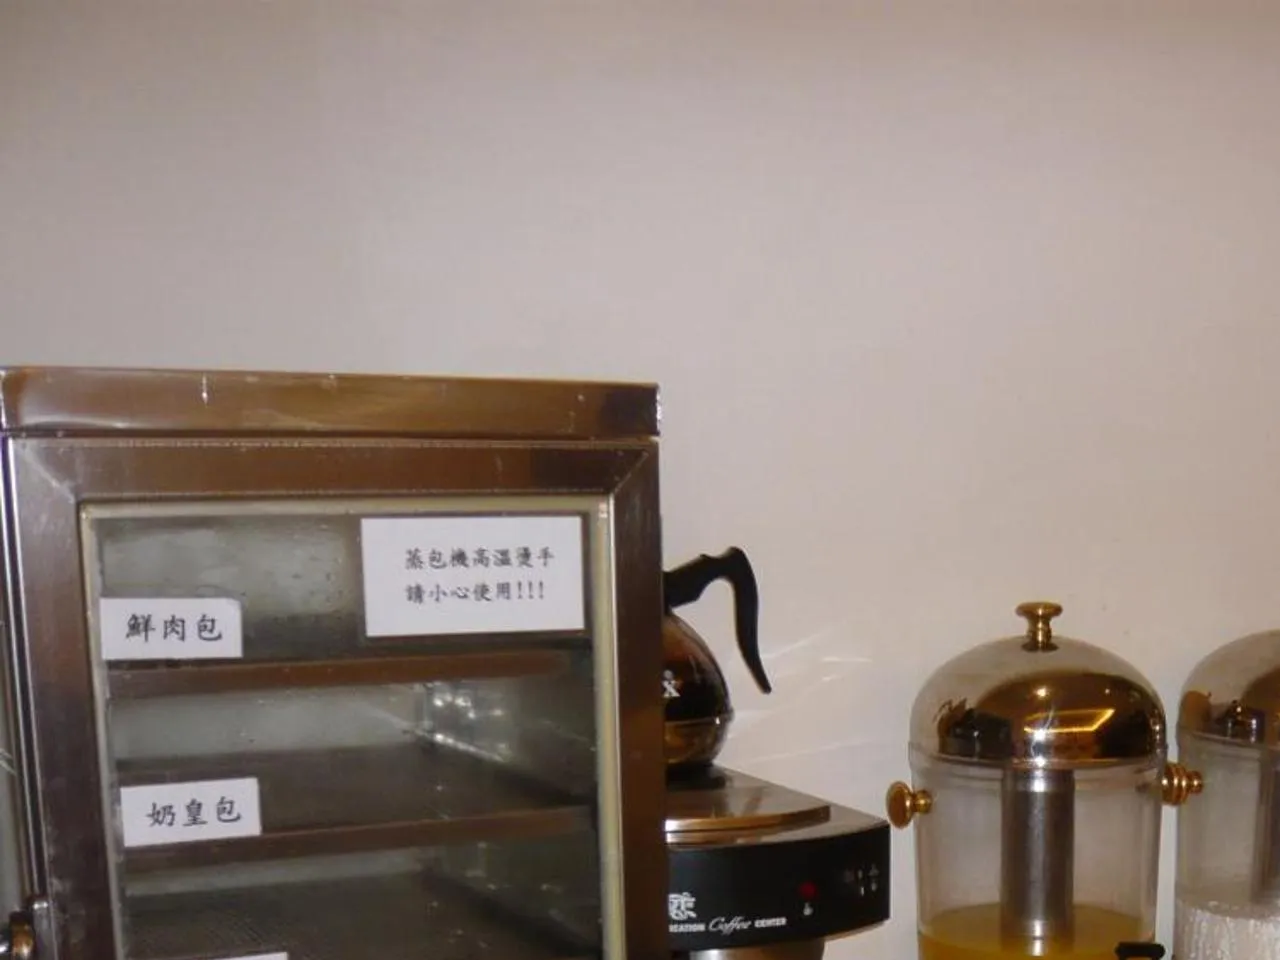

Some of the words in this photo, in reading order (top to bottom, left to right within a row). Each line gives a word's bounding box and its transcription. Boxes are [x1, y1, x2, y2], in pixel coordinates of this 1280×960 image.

[125, 613, 223, 643] 鮮肉包
[146, 796, 242, 828] 奶皇包
